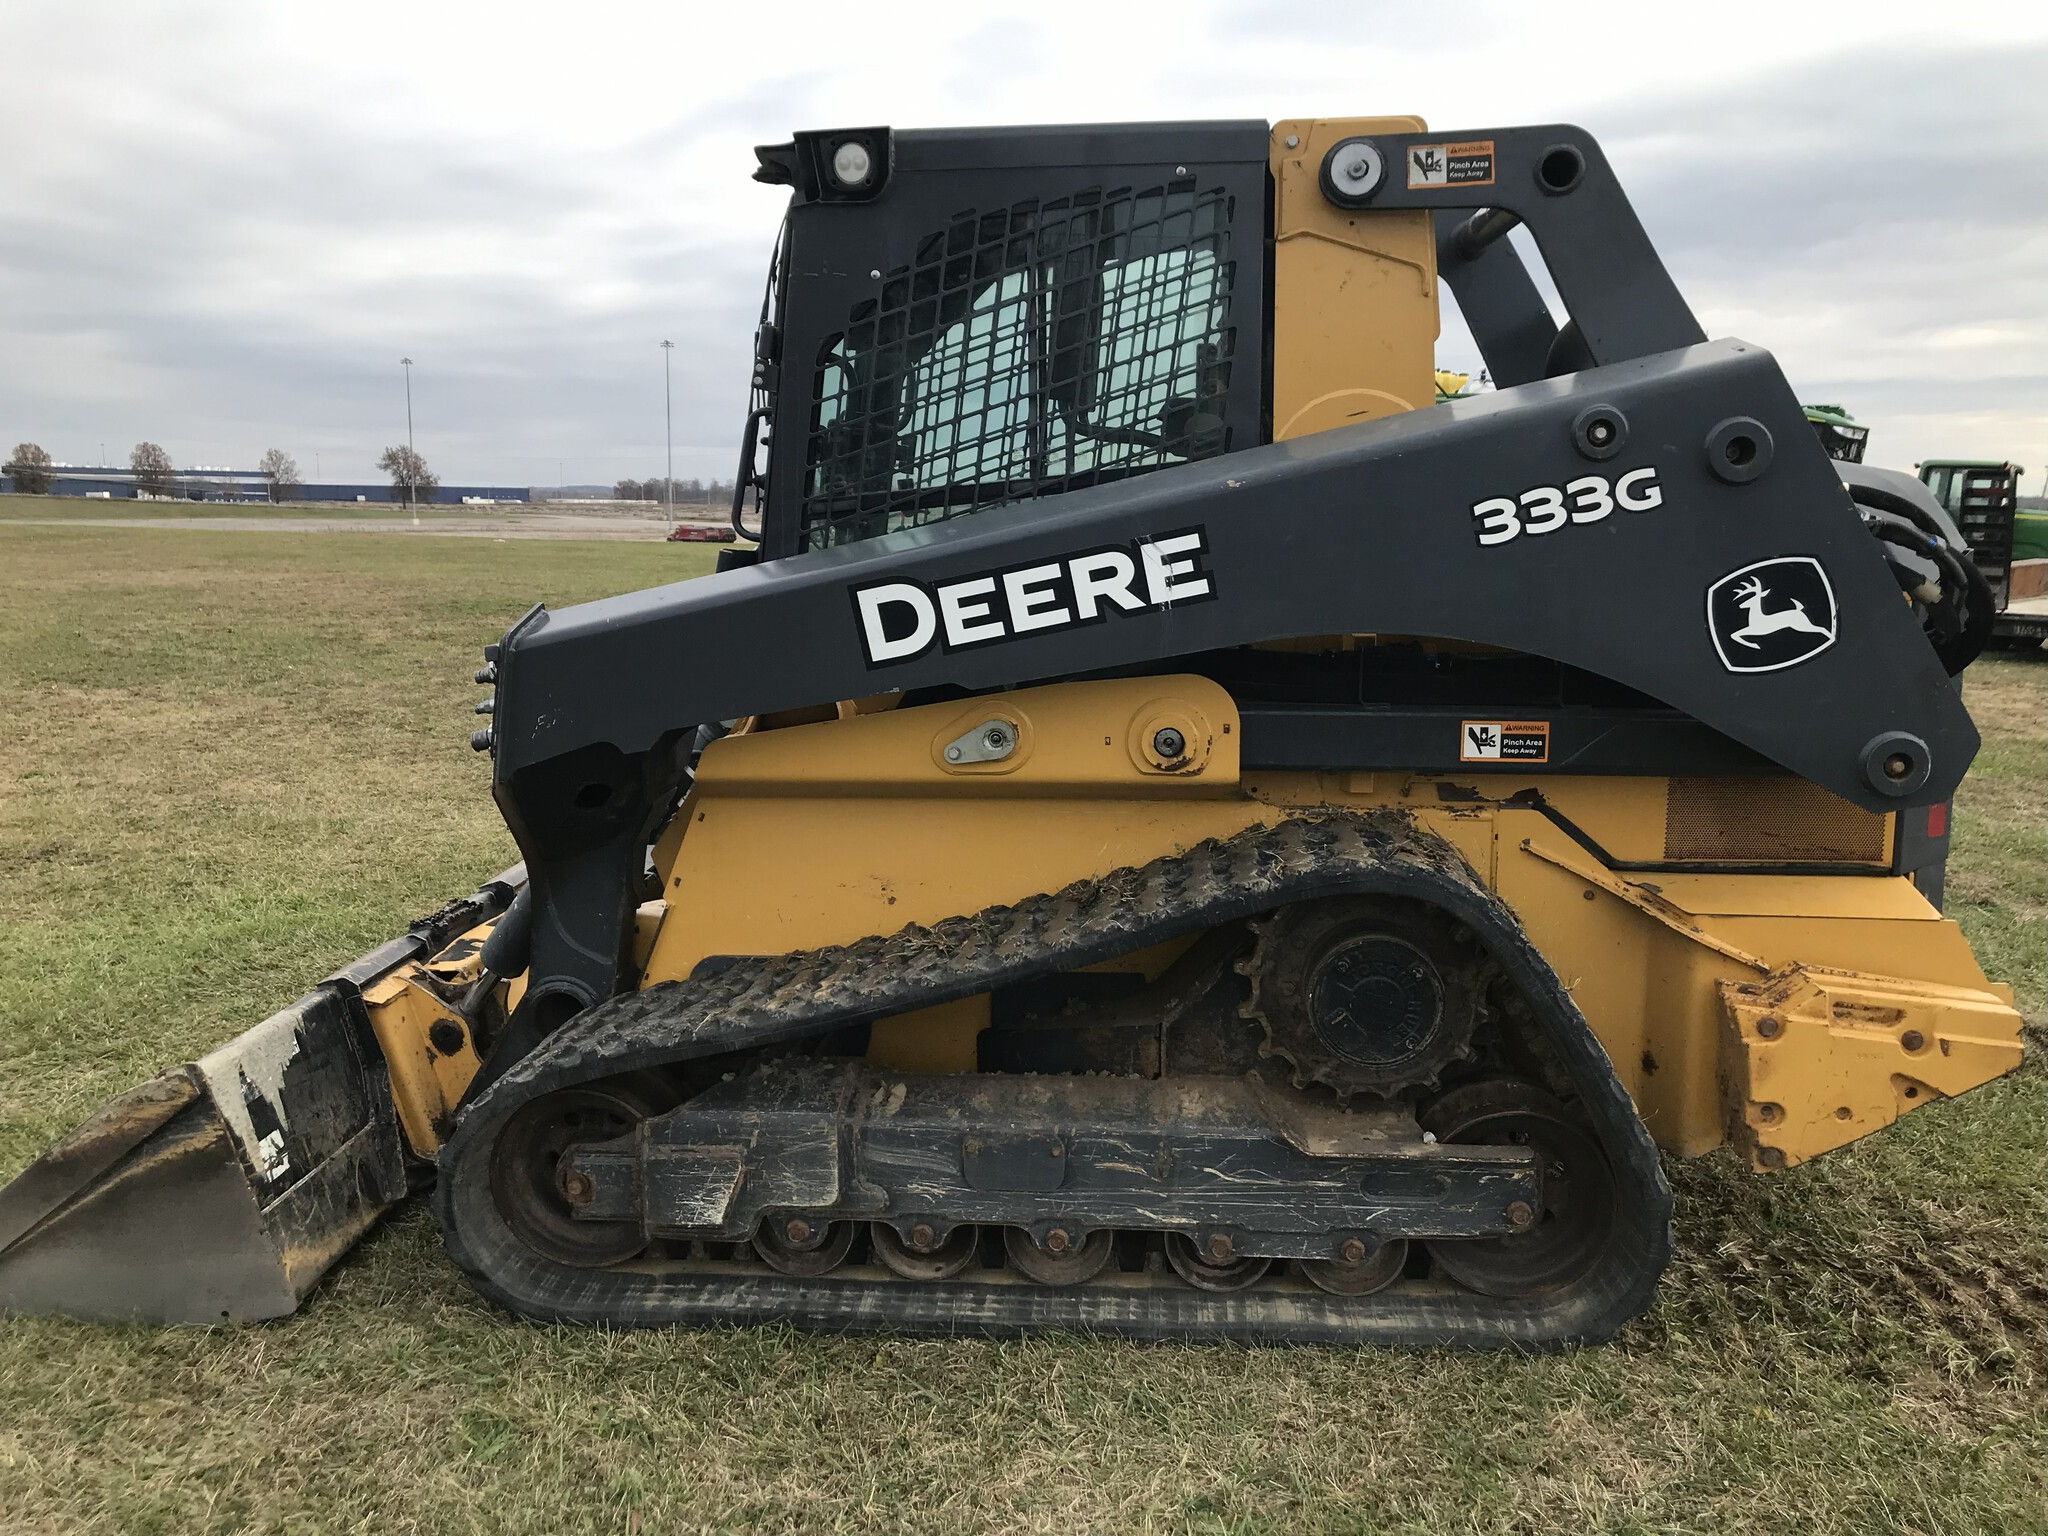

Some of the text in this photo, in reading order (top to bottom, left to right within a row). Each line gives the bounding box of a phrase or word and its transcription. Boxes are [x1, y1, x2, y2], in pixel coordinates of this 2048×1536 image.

[1450, 160, 1489, 169] Pinch Area
[1457, 145, 1490, 153] WARNING
[1473, 467, 1663, 545] 333G
[856, 532, 1210, 662] DEERE
